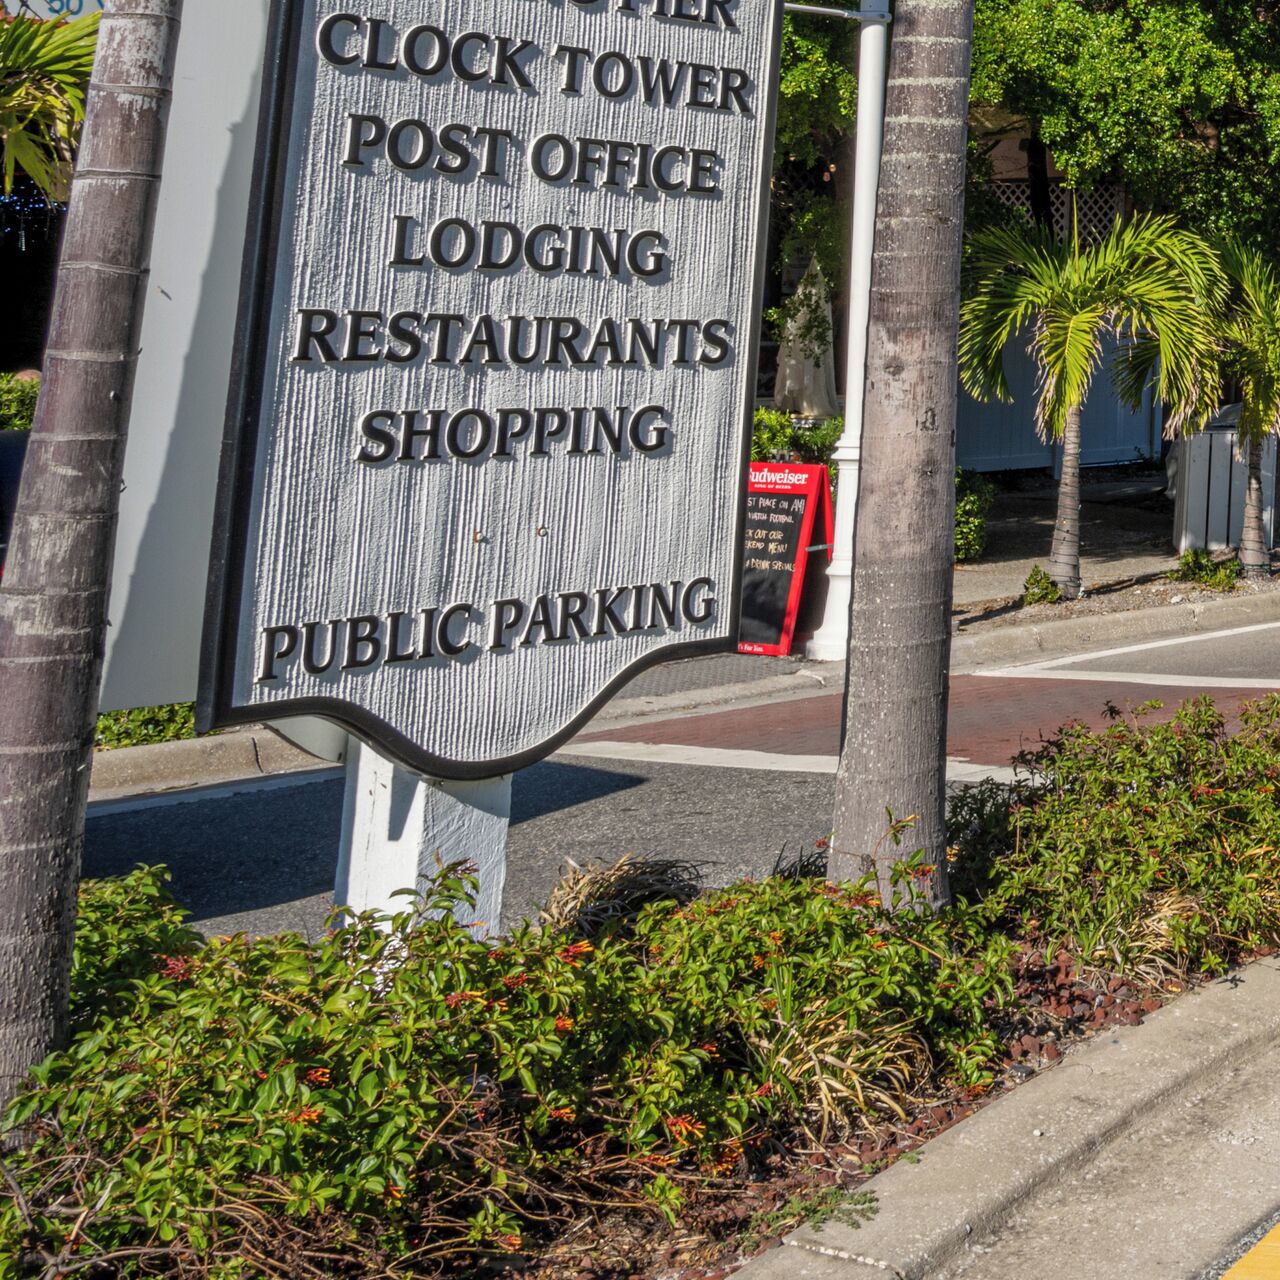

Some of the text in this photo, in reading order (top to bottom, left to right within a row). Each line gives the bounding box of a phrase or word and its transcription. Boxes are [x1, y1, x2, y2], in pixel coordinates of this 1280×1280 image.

[316, 13, 752, 114] CLOCK TOWER
[342, 113, 717, 194] POST OFFICE
[389, 214, 666, 277] LODGING
[290, 308, 731, 367] RESTAURANTS
[356, 404, 668, 464] SHOPPING
[750, 467, 808, 484] udweiser
[754, 529, 768, 539] OUT
[255, 577, 716, 683] PUBLIC PARKING
